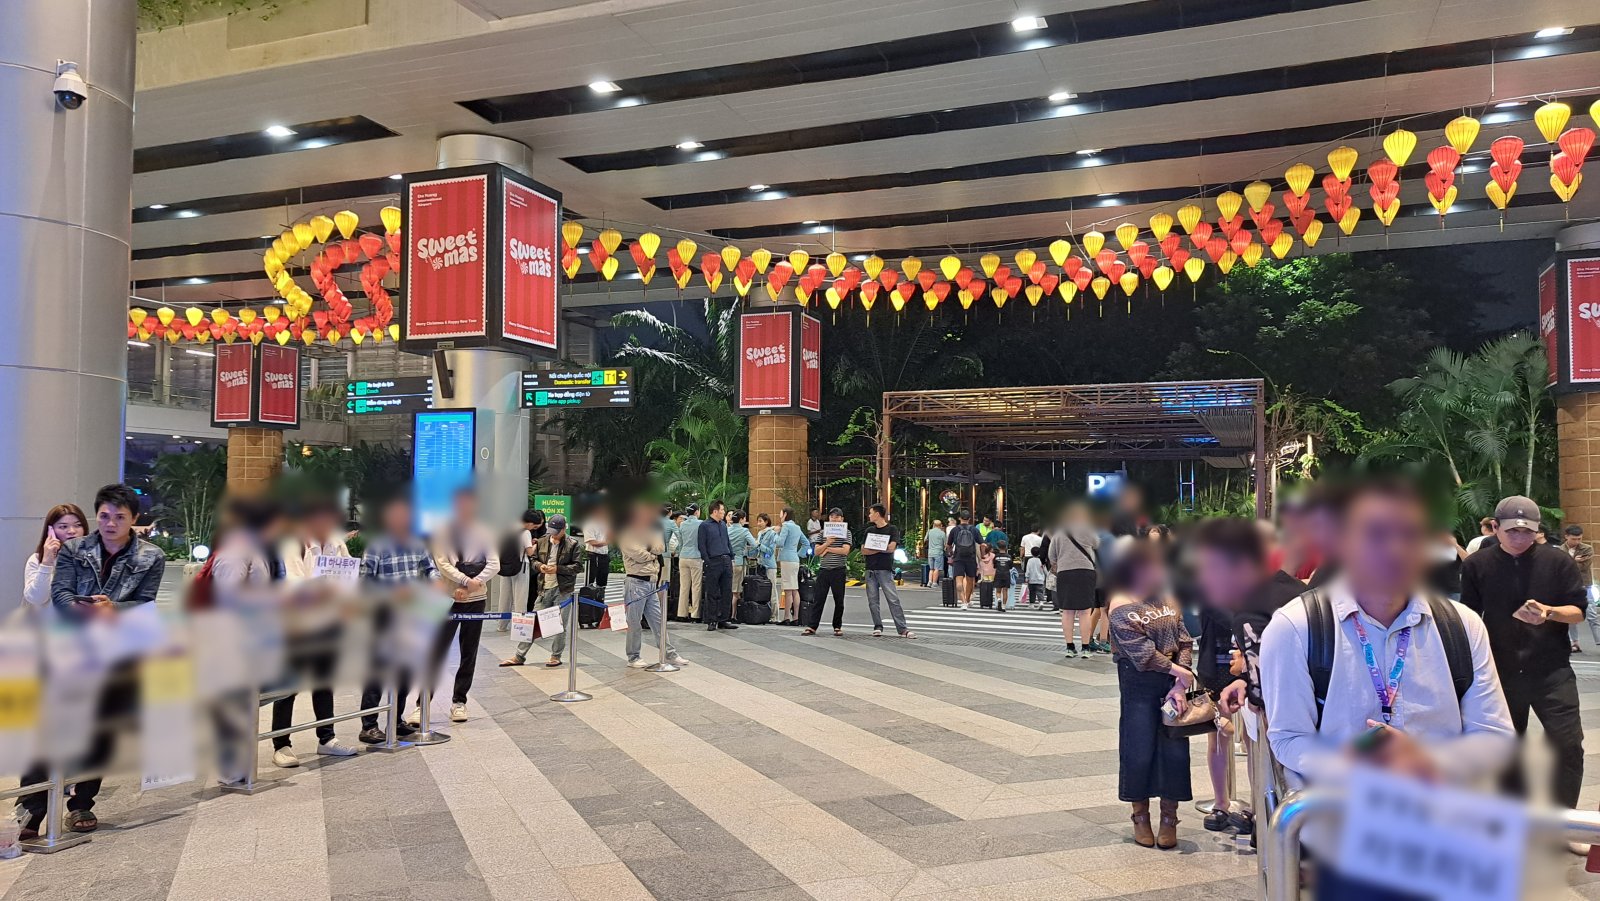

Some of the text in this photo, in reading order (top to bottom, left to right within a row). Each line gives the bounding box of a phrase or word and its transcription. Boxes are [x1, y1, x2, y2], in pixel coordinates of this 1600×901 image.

[417, 229, 478, 259] Sweet
[510, 238, 551, 262] Sweet
[444, 246, 478, 268] mas
[528, 260, 552, 278] mas
[746, 344, 785, 360] Sweet
[764, 353, 786, 365] mas
[220, 368, 248, 382] Sweet
[232, 376, 248, 386] mas
[264, 372, 293, 382] Sweet
[606, 373, 616, 382] T1
[278, 380, 294, 389] mas
[328, 558, 356, 569] 하나투어
